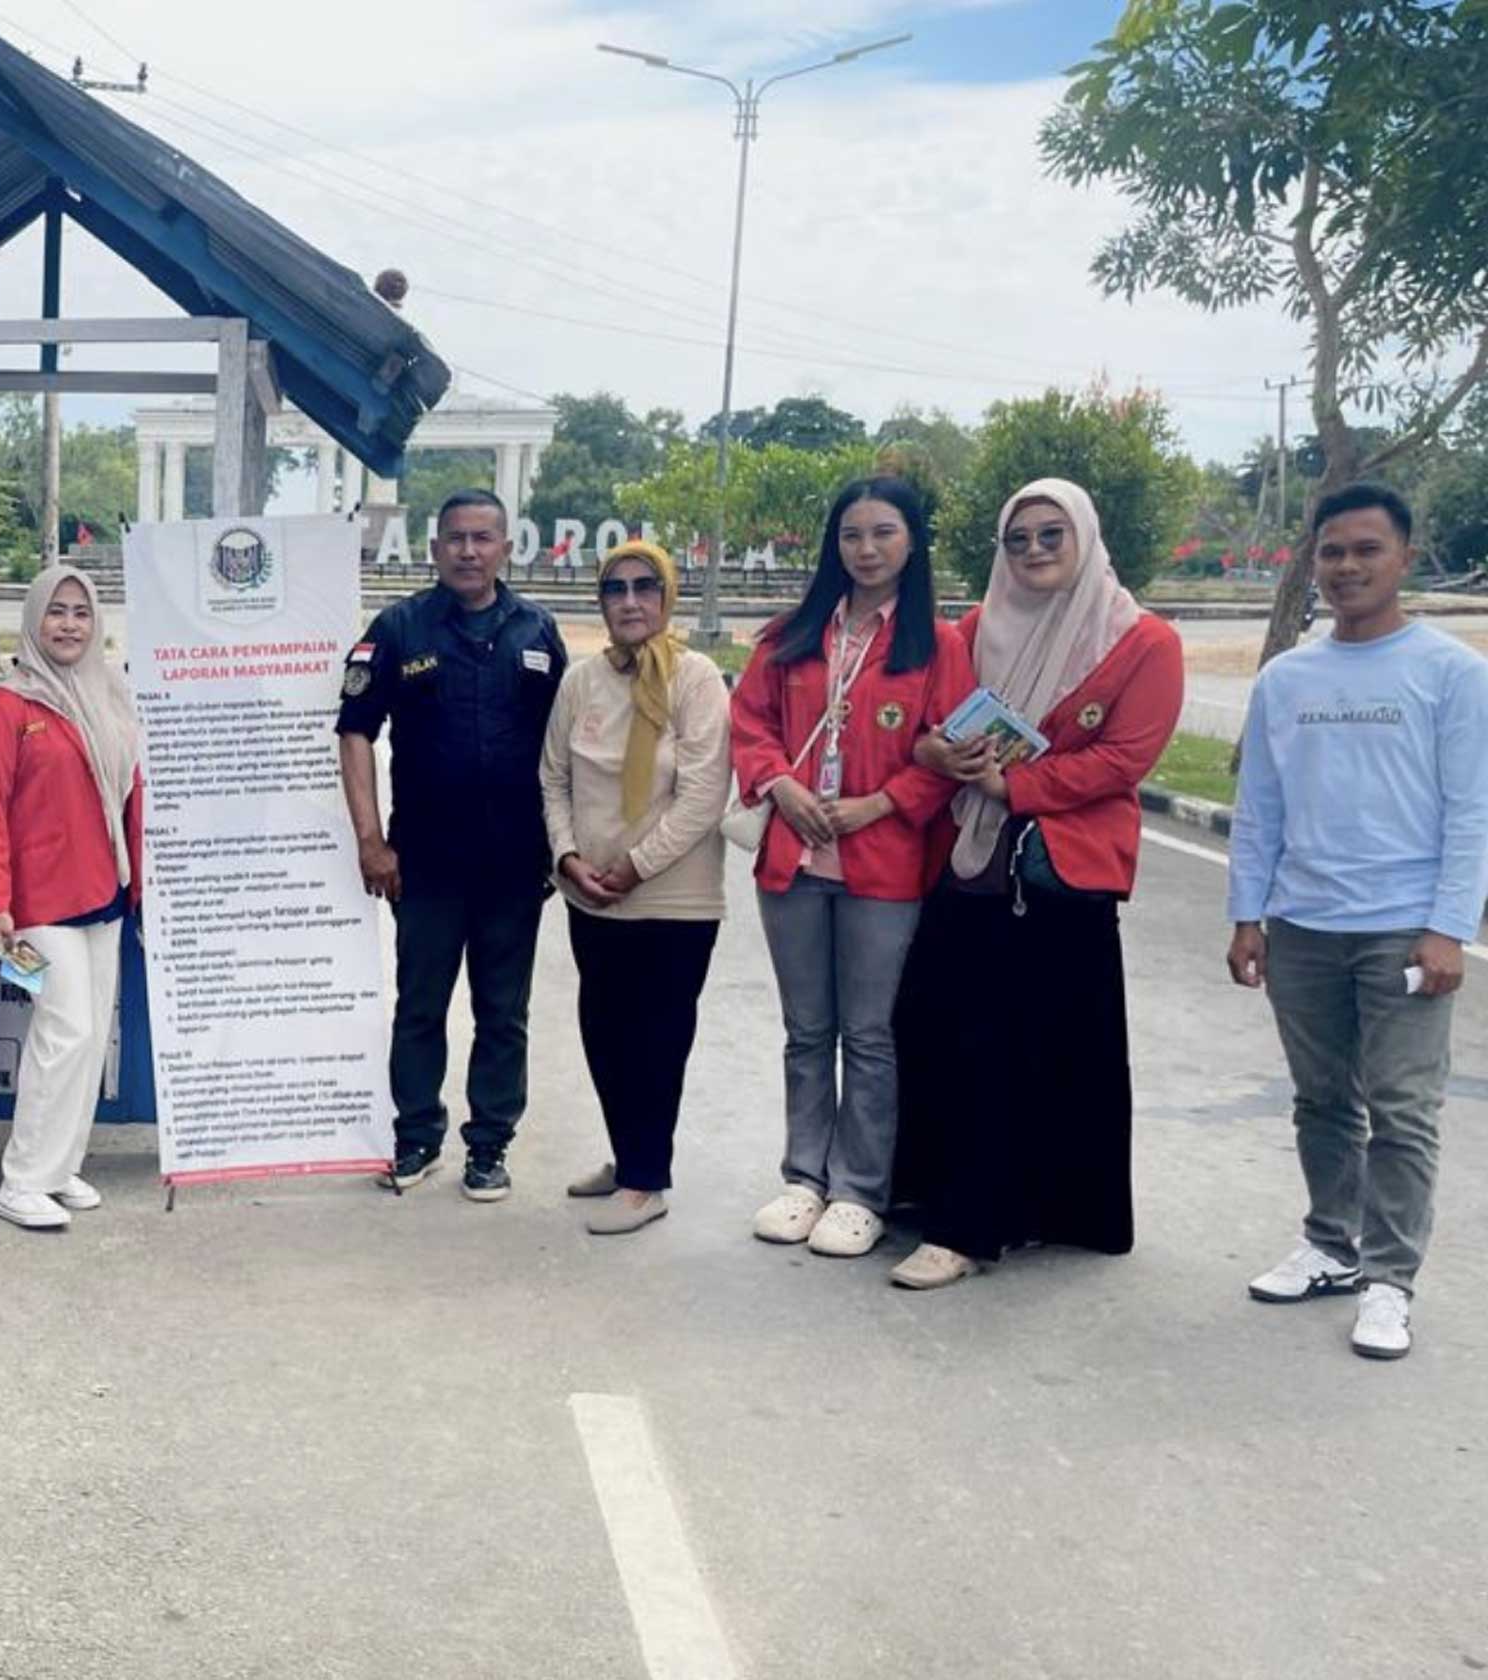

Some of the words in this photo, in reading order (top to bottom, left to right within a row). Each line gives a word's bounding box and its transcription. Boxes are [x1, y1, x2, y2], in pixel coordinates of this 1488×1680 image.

[154, 648, 186, 661] TATA
[191, 646, 228, 659] CARA
[232, 641, 337, 657] PENYAMPAIAN
[162, 664, 229, 680] LAPORAN
[234, 660, 330, 677] MASYARAKAT
